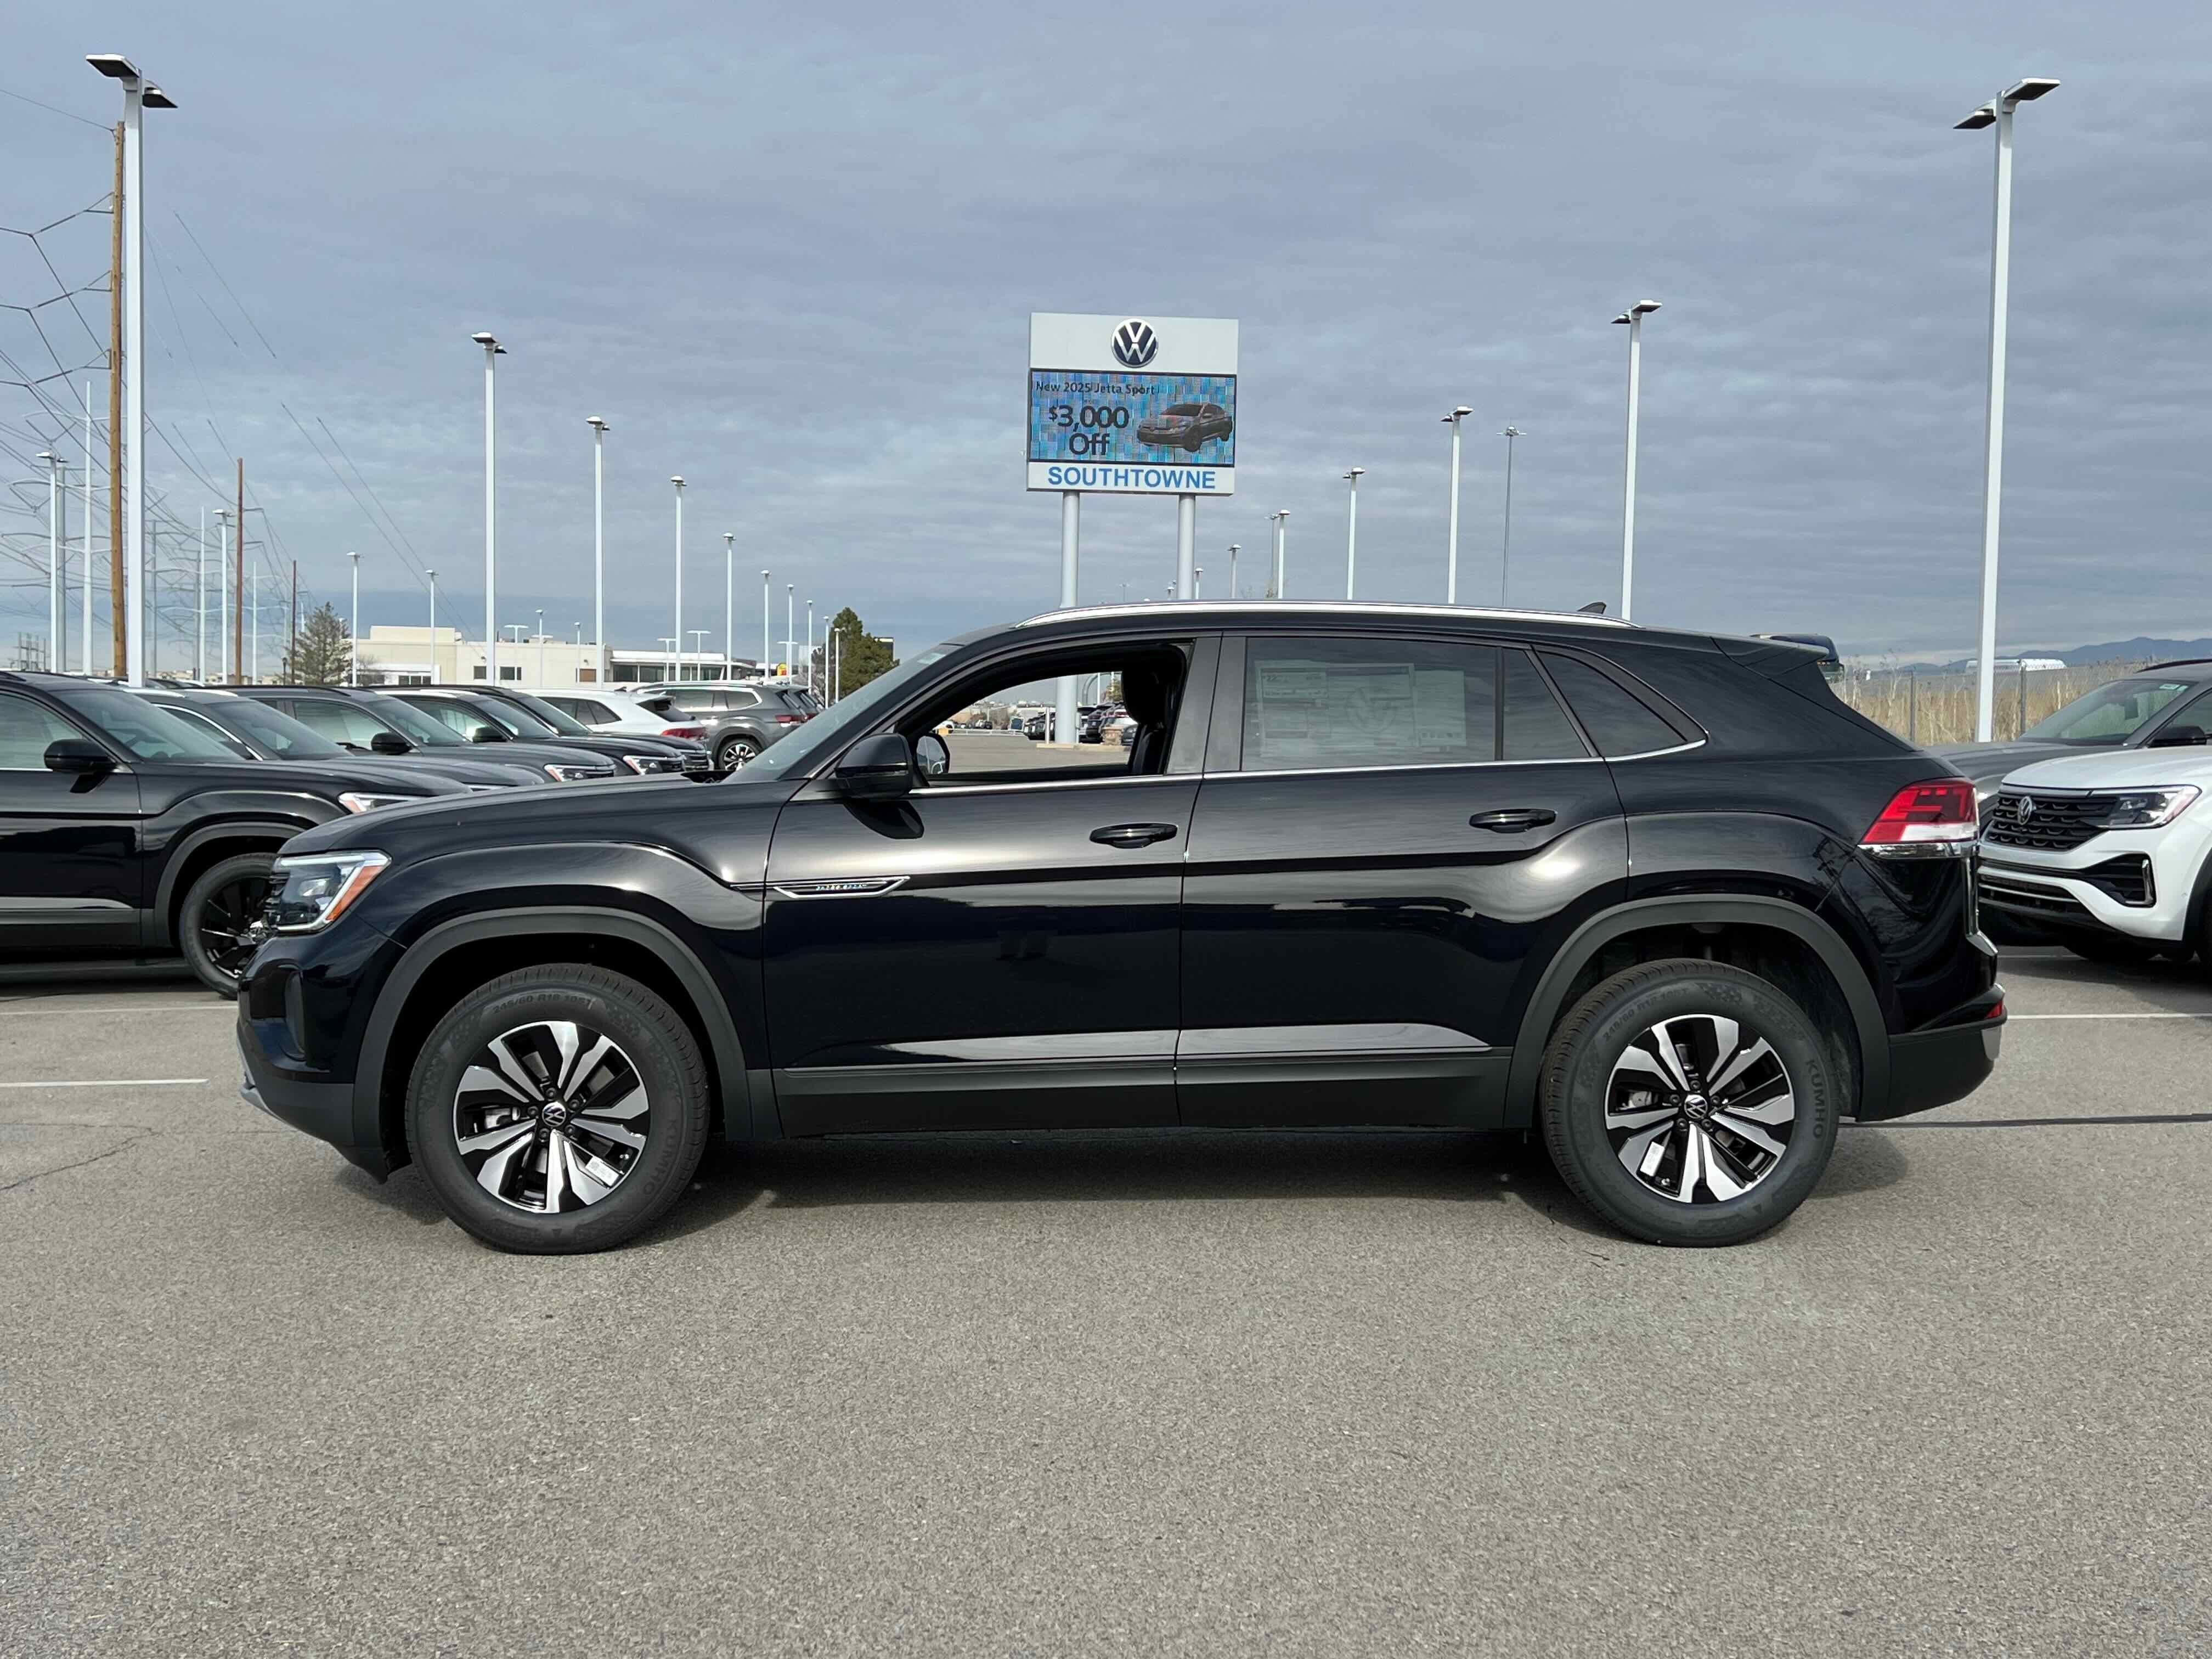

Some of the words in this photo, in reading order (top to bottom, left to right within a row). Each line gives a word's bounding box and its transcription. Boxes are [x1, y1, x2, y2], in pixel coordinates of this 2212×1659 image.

[1036, 381, 1060, 392] New
[1064, 382, 1092, 393] 2025
[1094, 383, 1122, 393] Jetta
[1125, 384, 1155, 396] Sport
[1048, 404, 1130, 432] $3,000
[1069, 433, 1110, 455] Off
[1048, 466, 1216, 489] SOUTHTOWNE
[1805, 1059, 1825, 1139] KUMHO
